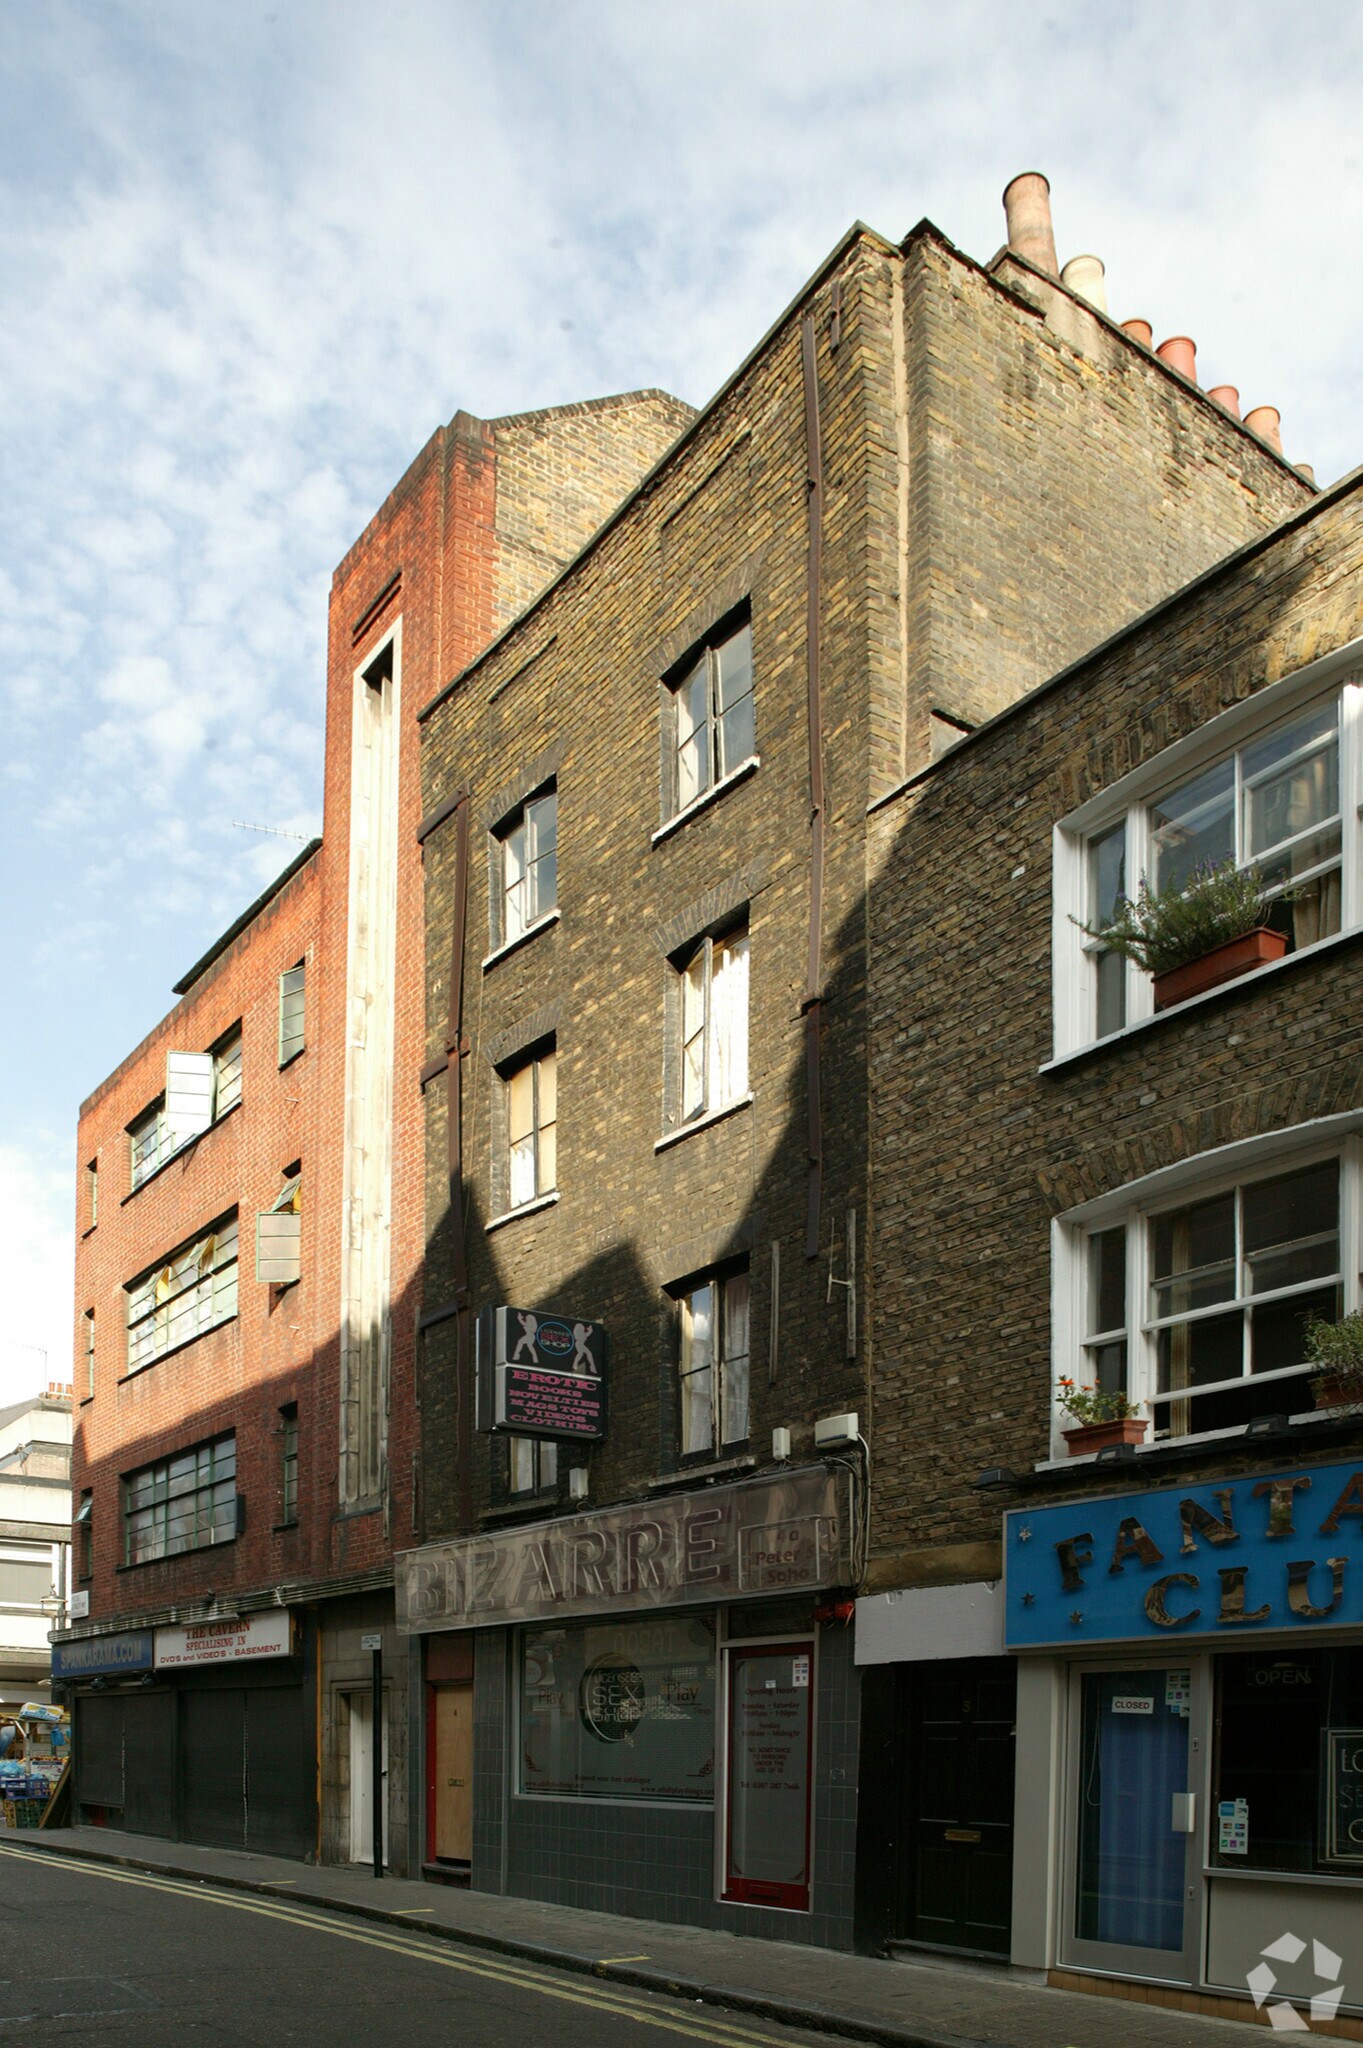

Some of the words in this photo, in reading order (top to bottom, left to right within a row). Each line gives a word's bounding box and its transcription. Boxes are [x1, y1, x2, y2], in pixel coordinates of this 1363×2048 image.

[540, 1333, 569, 1342] SEX
[541, 1339, 570, 1348] SHOP
[512, 1370, 597, 1391] EROTIC
[509, 1389, 600, 1409] NOVELTIES
[528, 1384, 582, 1398] BOOKS
[510, 1398, 558, 1411] MAGS
[560, 1405, 599, 1417] TOYS
[524, 1408, 586, 1423] VIDEOS
[510, 1414, 598, 1432] CLOTHING
[406, 1507, 724, 1619] BIZARRE
[756, 1549, 800, 1565] Peter
[767, 1567, 810, 1583] Soho
[1144, 1556, 1350, 1628] CLU
[185, 1637, 234, 1652] SPECIALISING
[237, 1635, 247, 1646] IN
[61, 1640, 142, 1670] SPANKARAMA.COM
[183, 1654, 195, 1662] and
[235, 1643, 282, 1656] BASEMENT
[1254, 1669, 1312, 1685] OPEN
[592, 1685, 640, 1707] SEX
[667, 1681, 700, 1705] Play
[745, 1688, 773, 1697] Opening
[1114, 1701, 1150, 1709] CLOSED
[592, 1706, 642, 1723] SHOP
